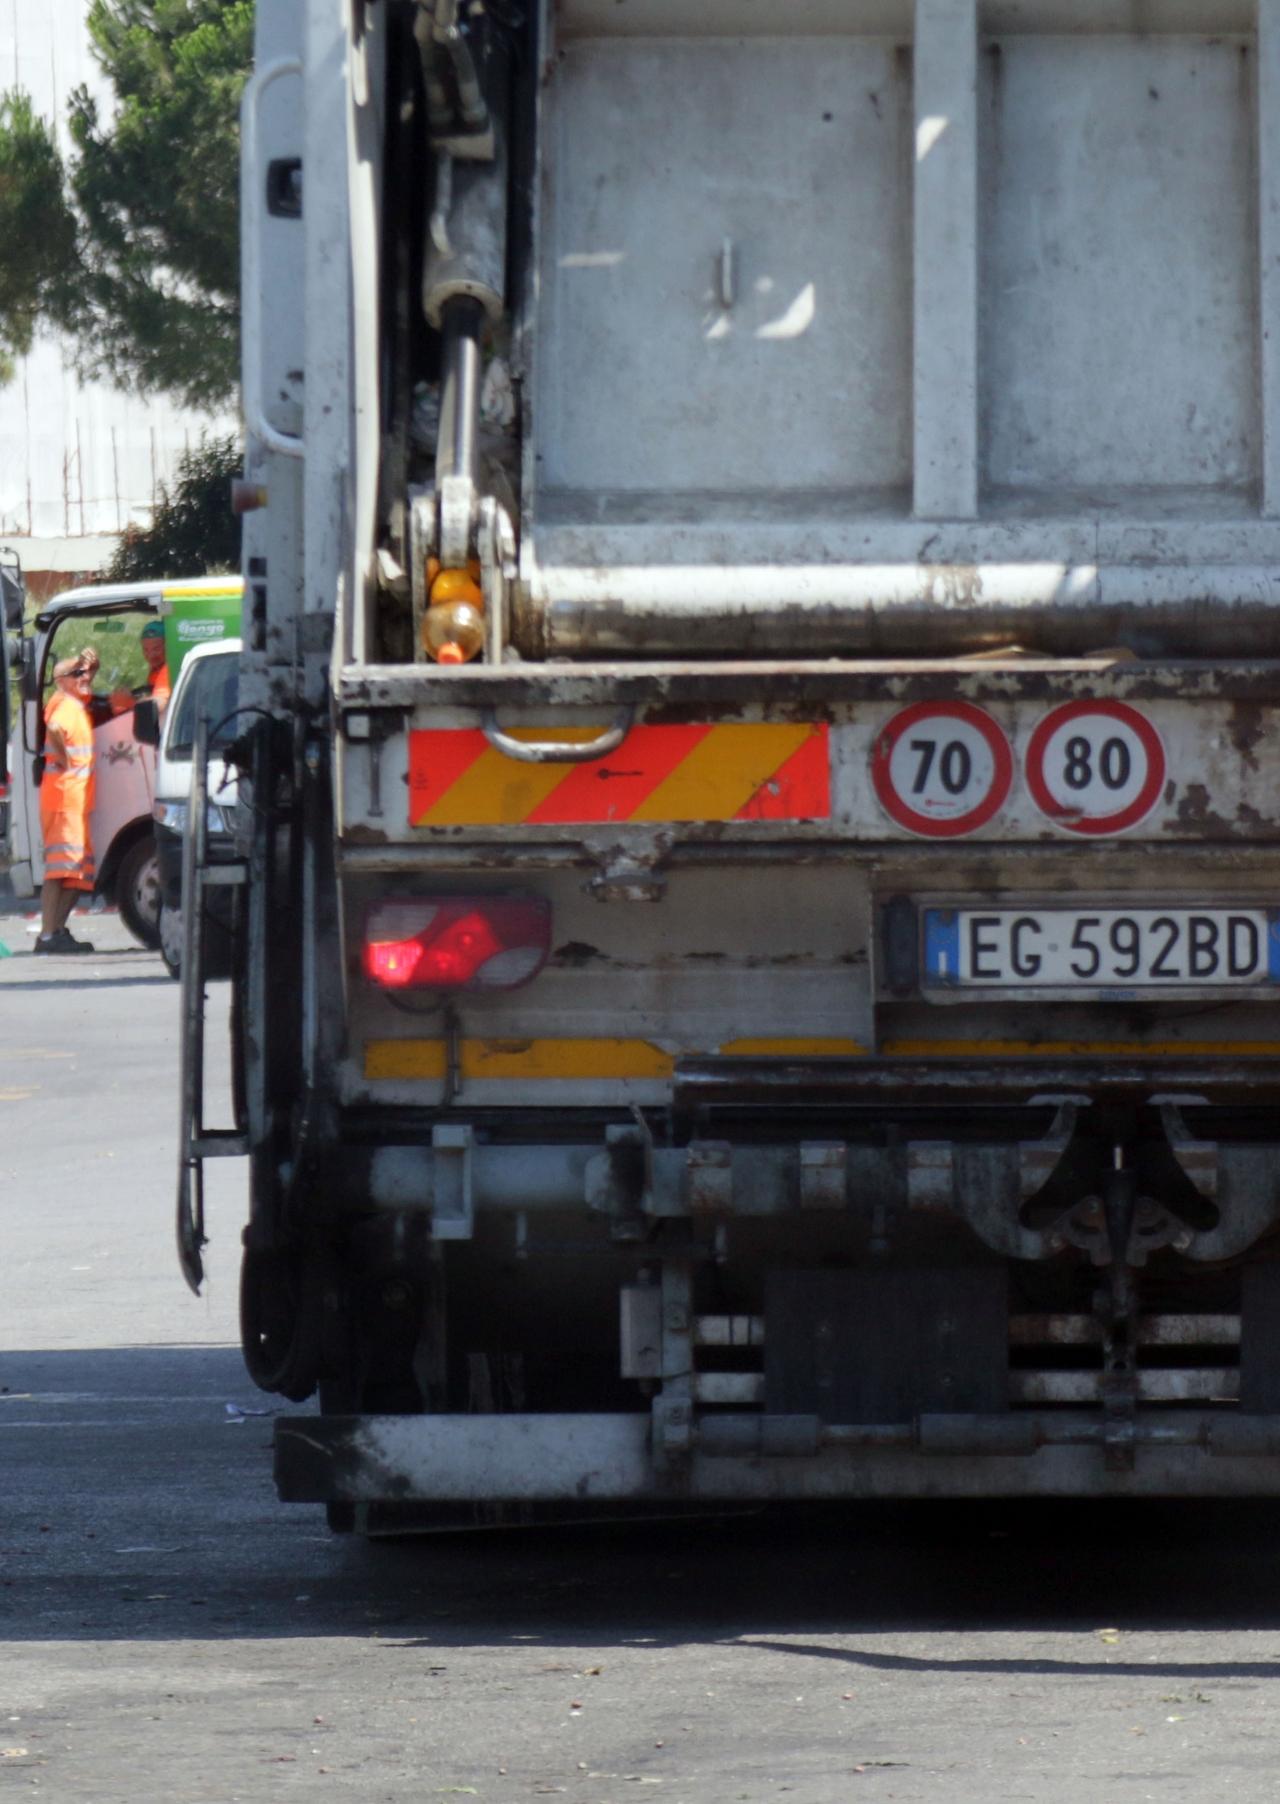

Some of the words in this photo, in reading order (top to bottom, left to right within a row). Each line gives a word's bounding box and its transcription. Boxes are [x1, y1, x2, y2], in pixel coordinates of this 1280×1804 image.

[909, 739, 972, 795] 70
[1062, 735, 1132, 791] 80
[968, 916, 1043, 978] EG
[1069, 916, 1260, 978] 592BD
